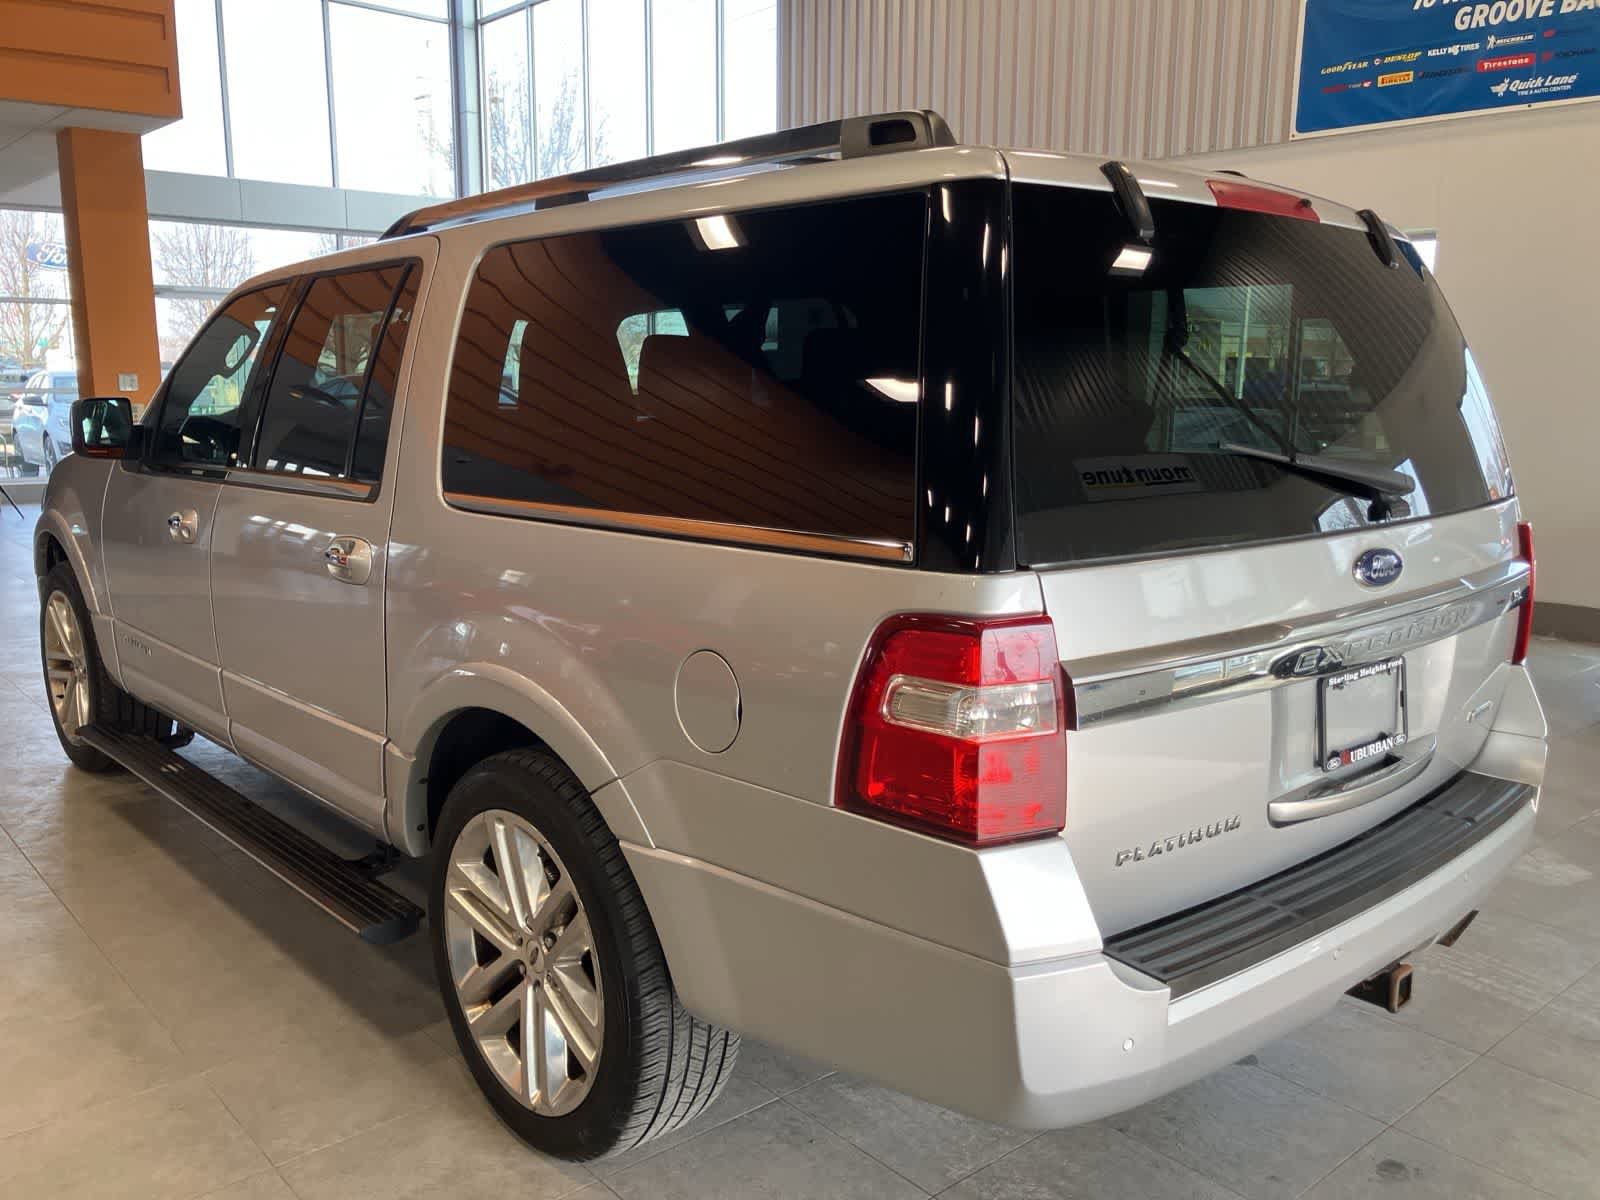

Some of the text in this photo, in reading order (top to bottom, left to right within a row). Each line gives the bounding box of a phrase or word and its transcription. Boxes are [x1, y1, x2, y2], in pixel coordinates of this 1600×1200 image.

[1454, 0, 1555, 31] GROOVE
[1427, 47, 1448, 57] KELLY
[1509, 74, 1578, 92] Quick Lane
[1328, 672, 1359, 687] Sterling
[1114, 814, 1241, 867] PLATINUM
